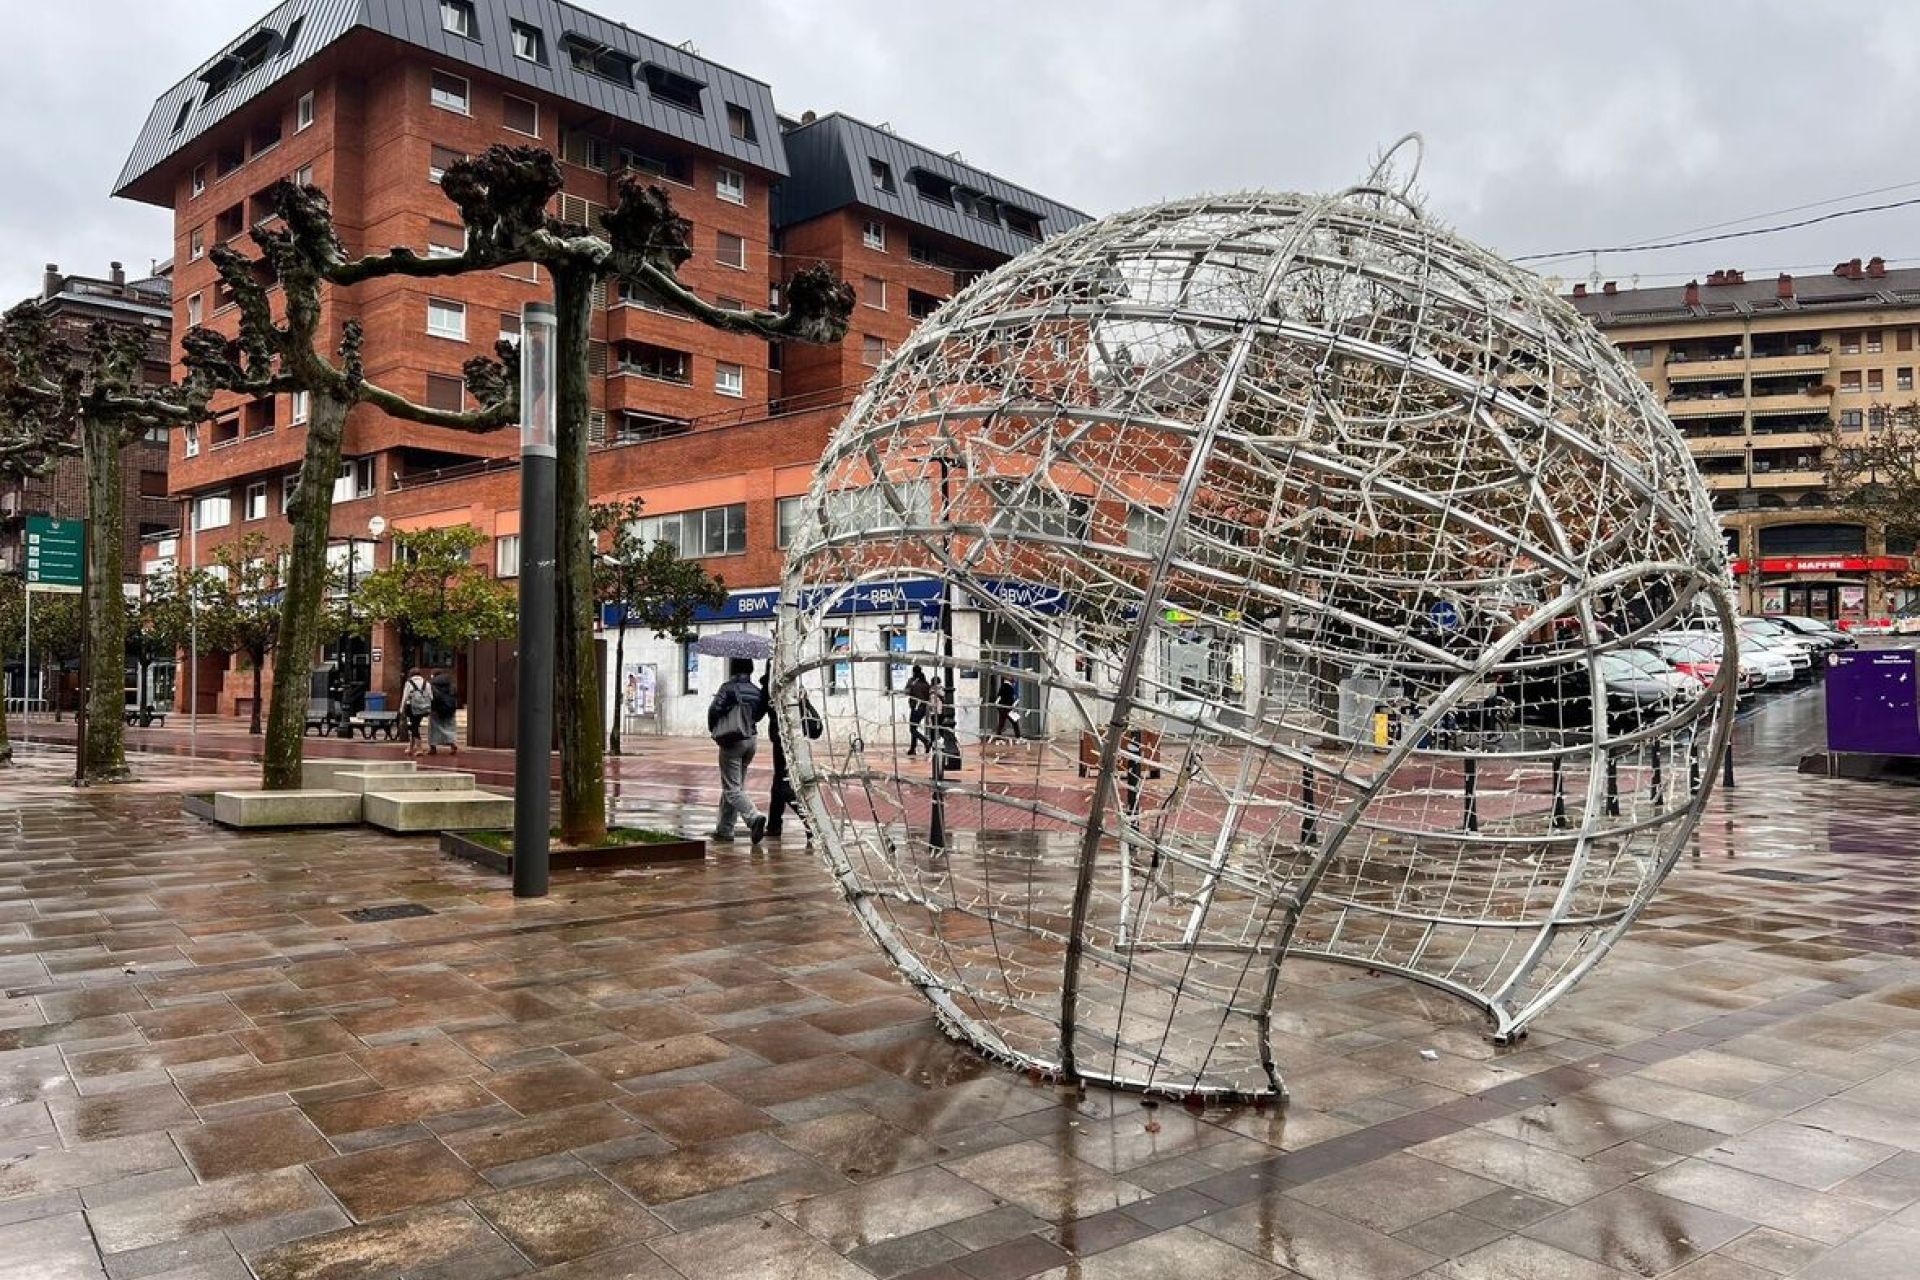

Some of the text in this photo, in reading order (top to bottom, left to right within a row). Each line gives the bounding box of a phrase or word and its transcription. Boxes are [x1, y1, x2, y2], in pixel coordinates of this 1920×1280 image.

[1797, 562, 1844, 570] MAPFRE
[871, 587, 906, 603] BBVA
[1000, 588, 1033, 605] BBVA
[738, 596, 768, 612] BBVA
